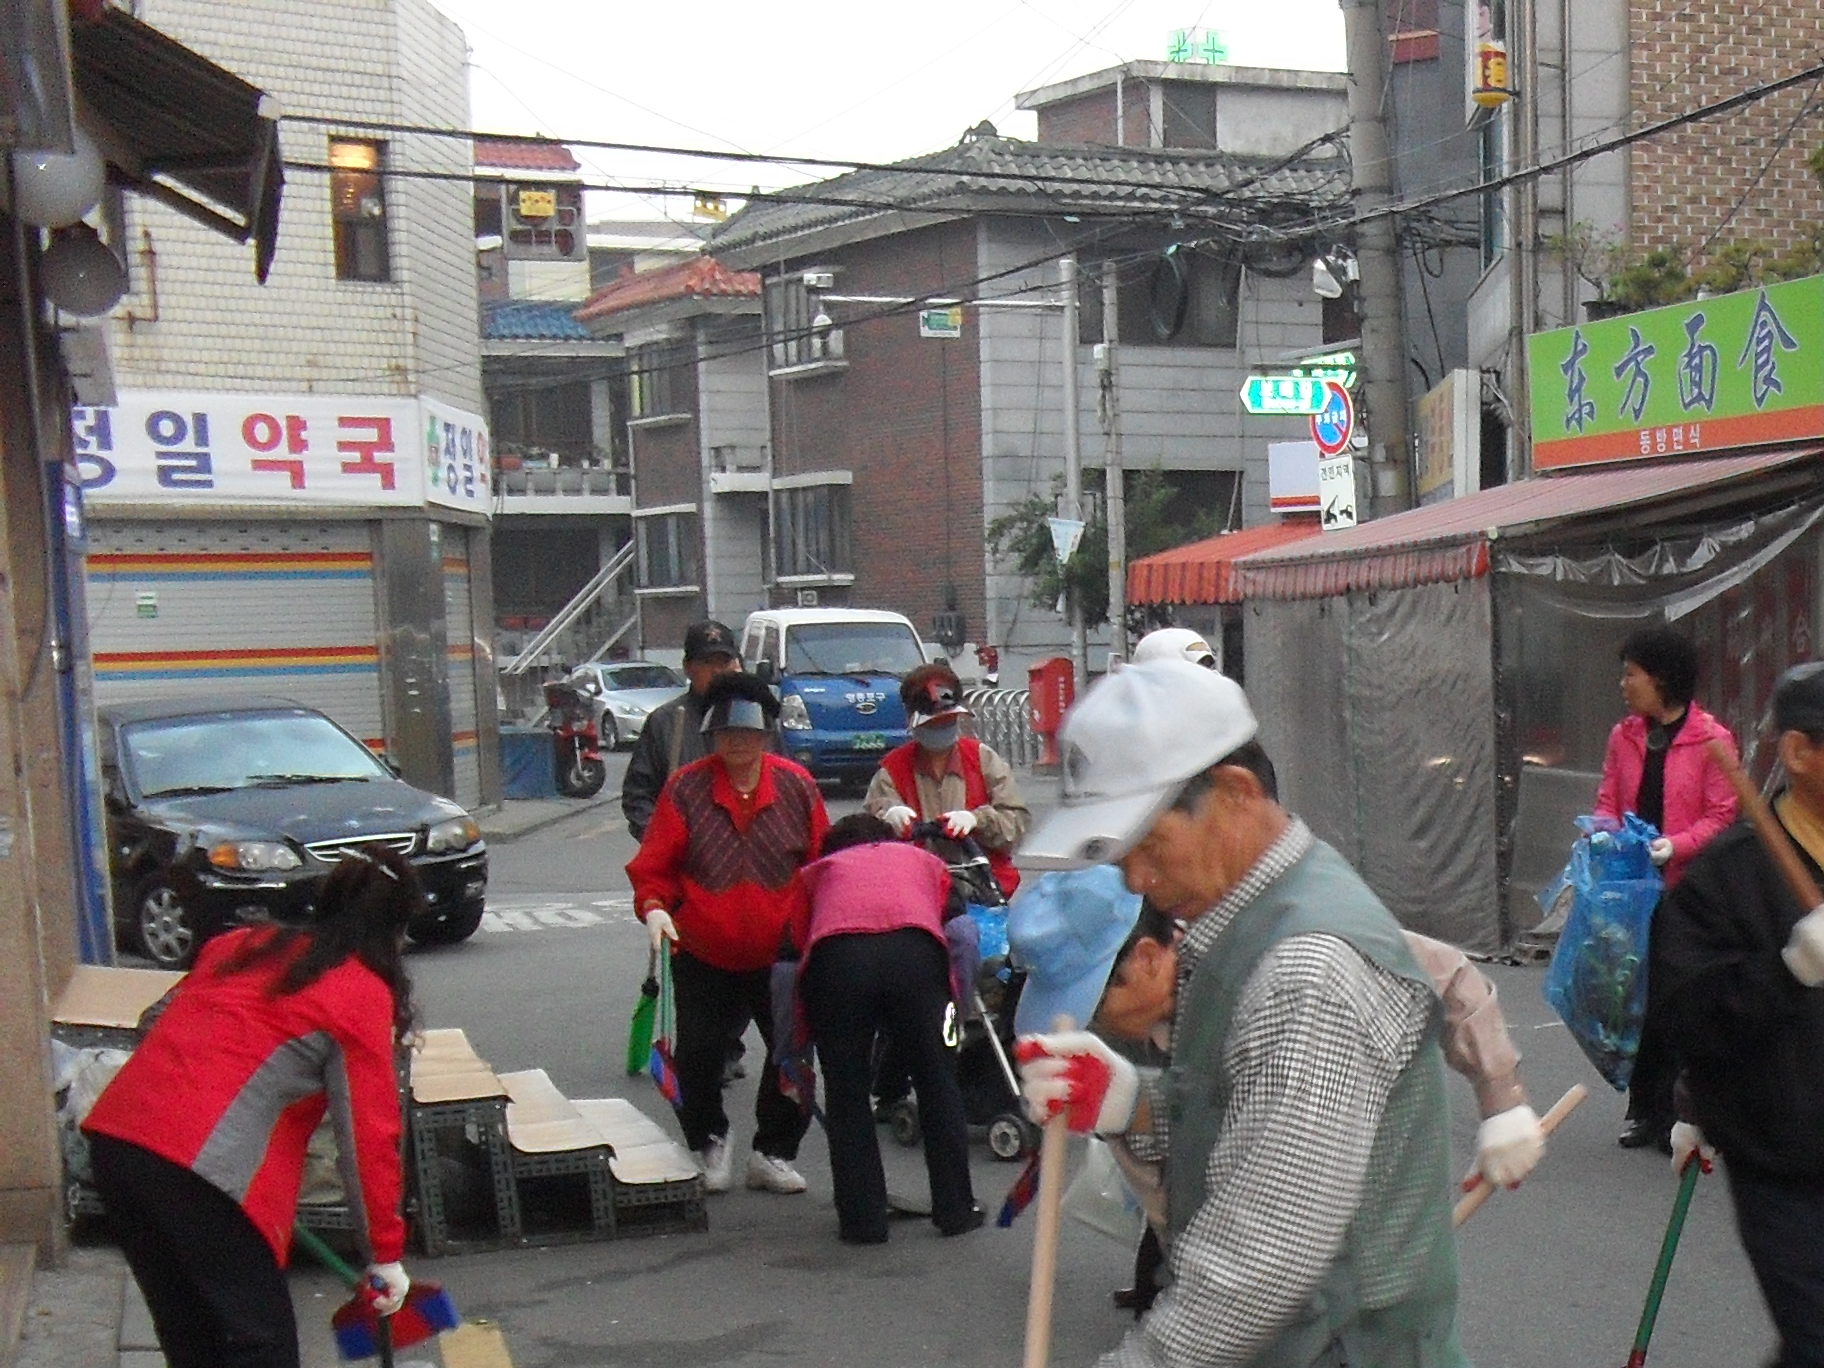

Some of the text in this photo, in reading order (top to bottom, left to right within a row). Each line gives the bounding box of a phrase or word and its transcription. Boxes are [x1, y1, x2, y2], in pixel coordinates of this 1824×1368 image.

[1561, 289, 1798, 433] 东方面食
[1641, 424, 1700, 454] 동방면식
